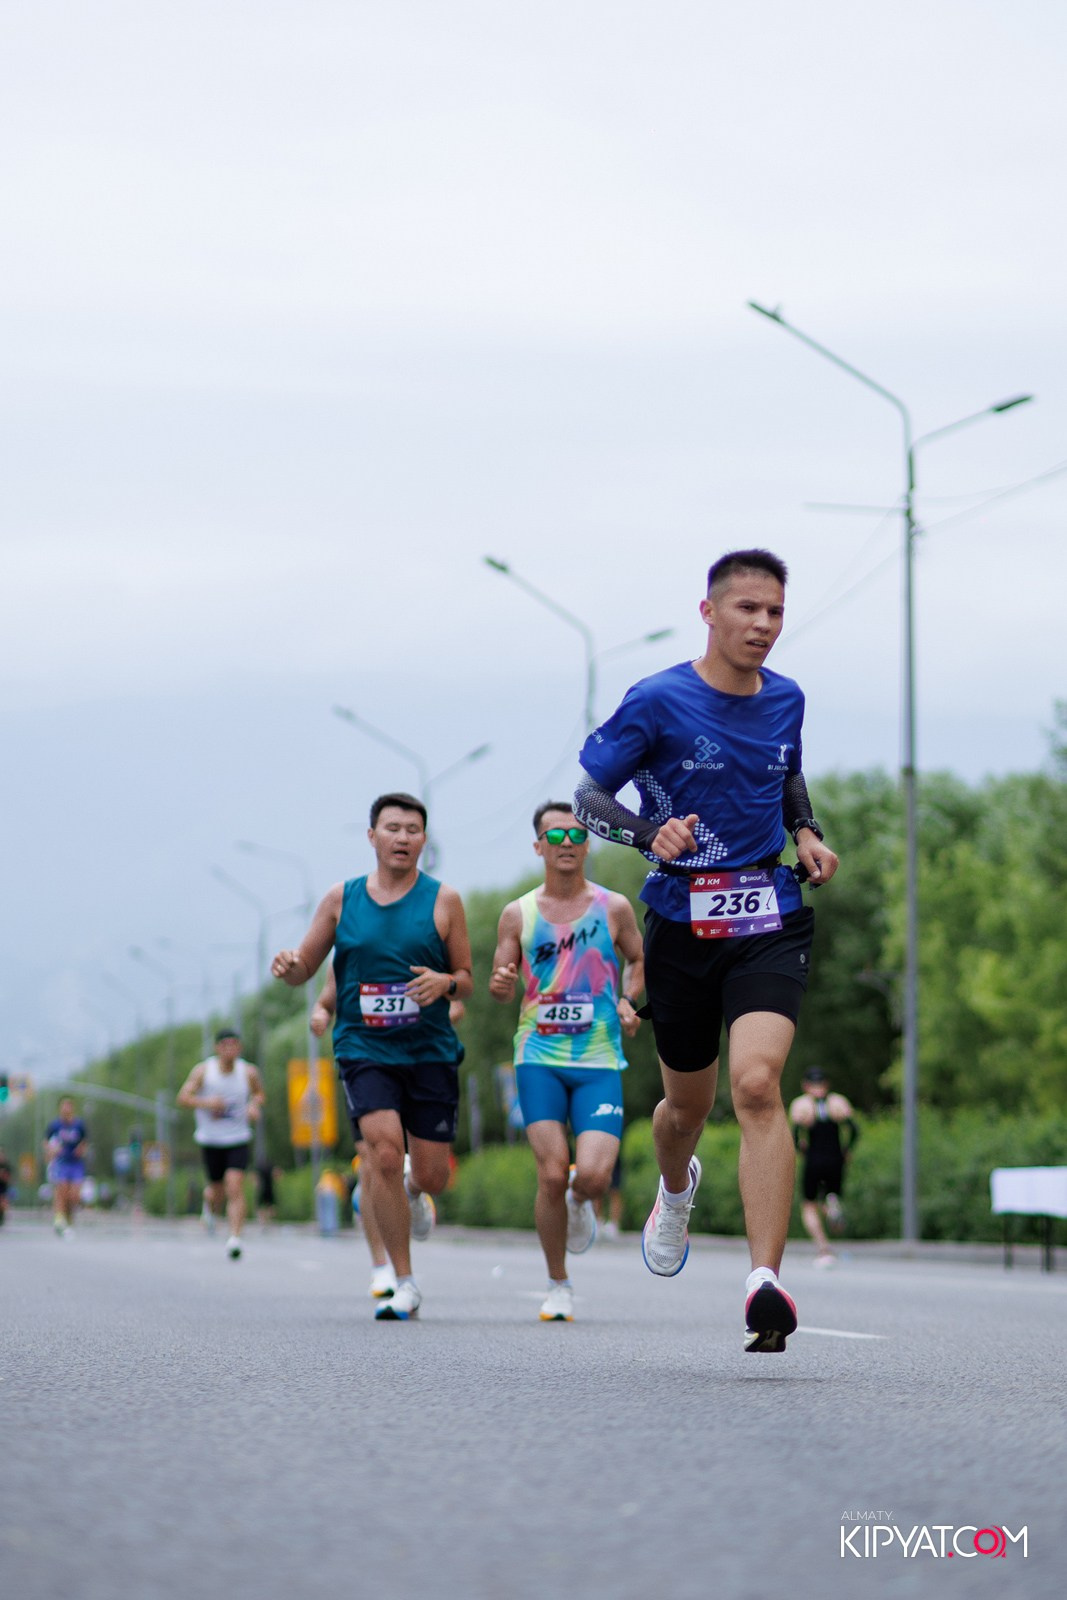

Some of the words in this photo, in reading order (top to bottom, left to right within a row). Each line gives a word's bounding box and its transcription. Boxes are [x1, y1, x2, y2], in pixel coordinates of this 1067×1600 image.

[694, 877, 705, 886] 10
[707, 891, 761, 917] 236
[372, 997, 405, 1013] 231
[544, 1006, 582, 1021] 485
